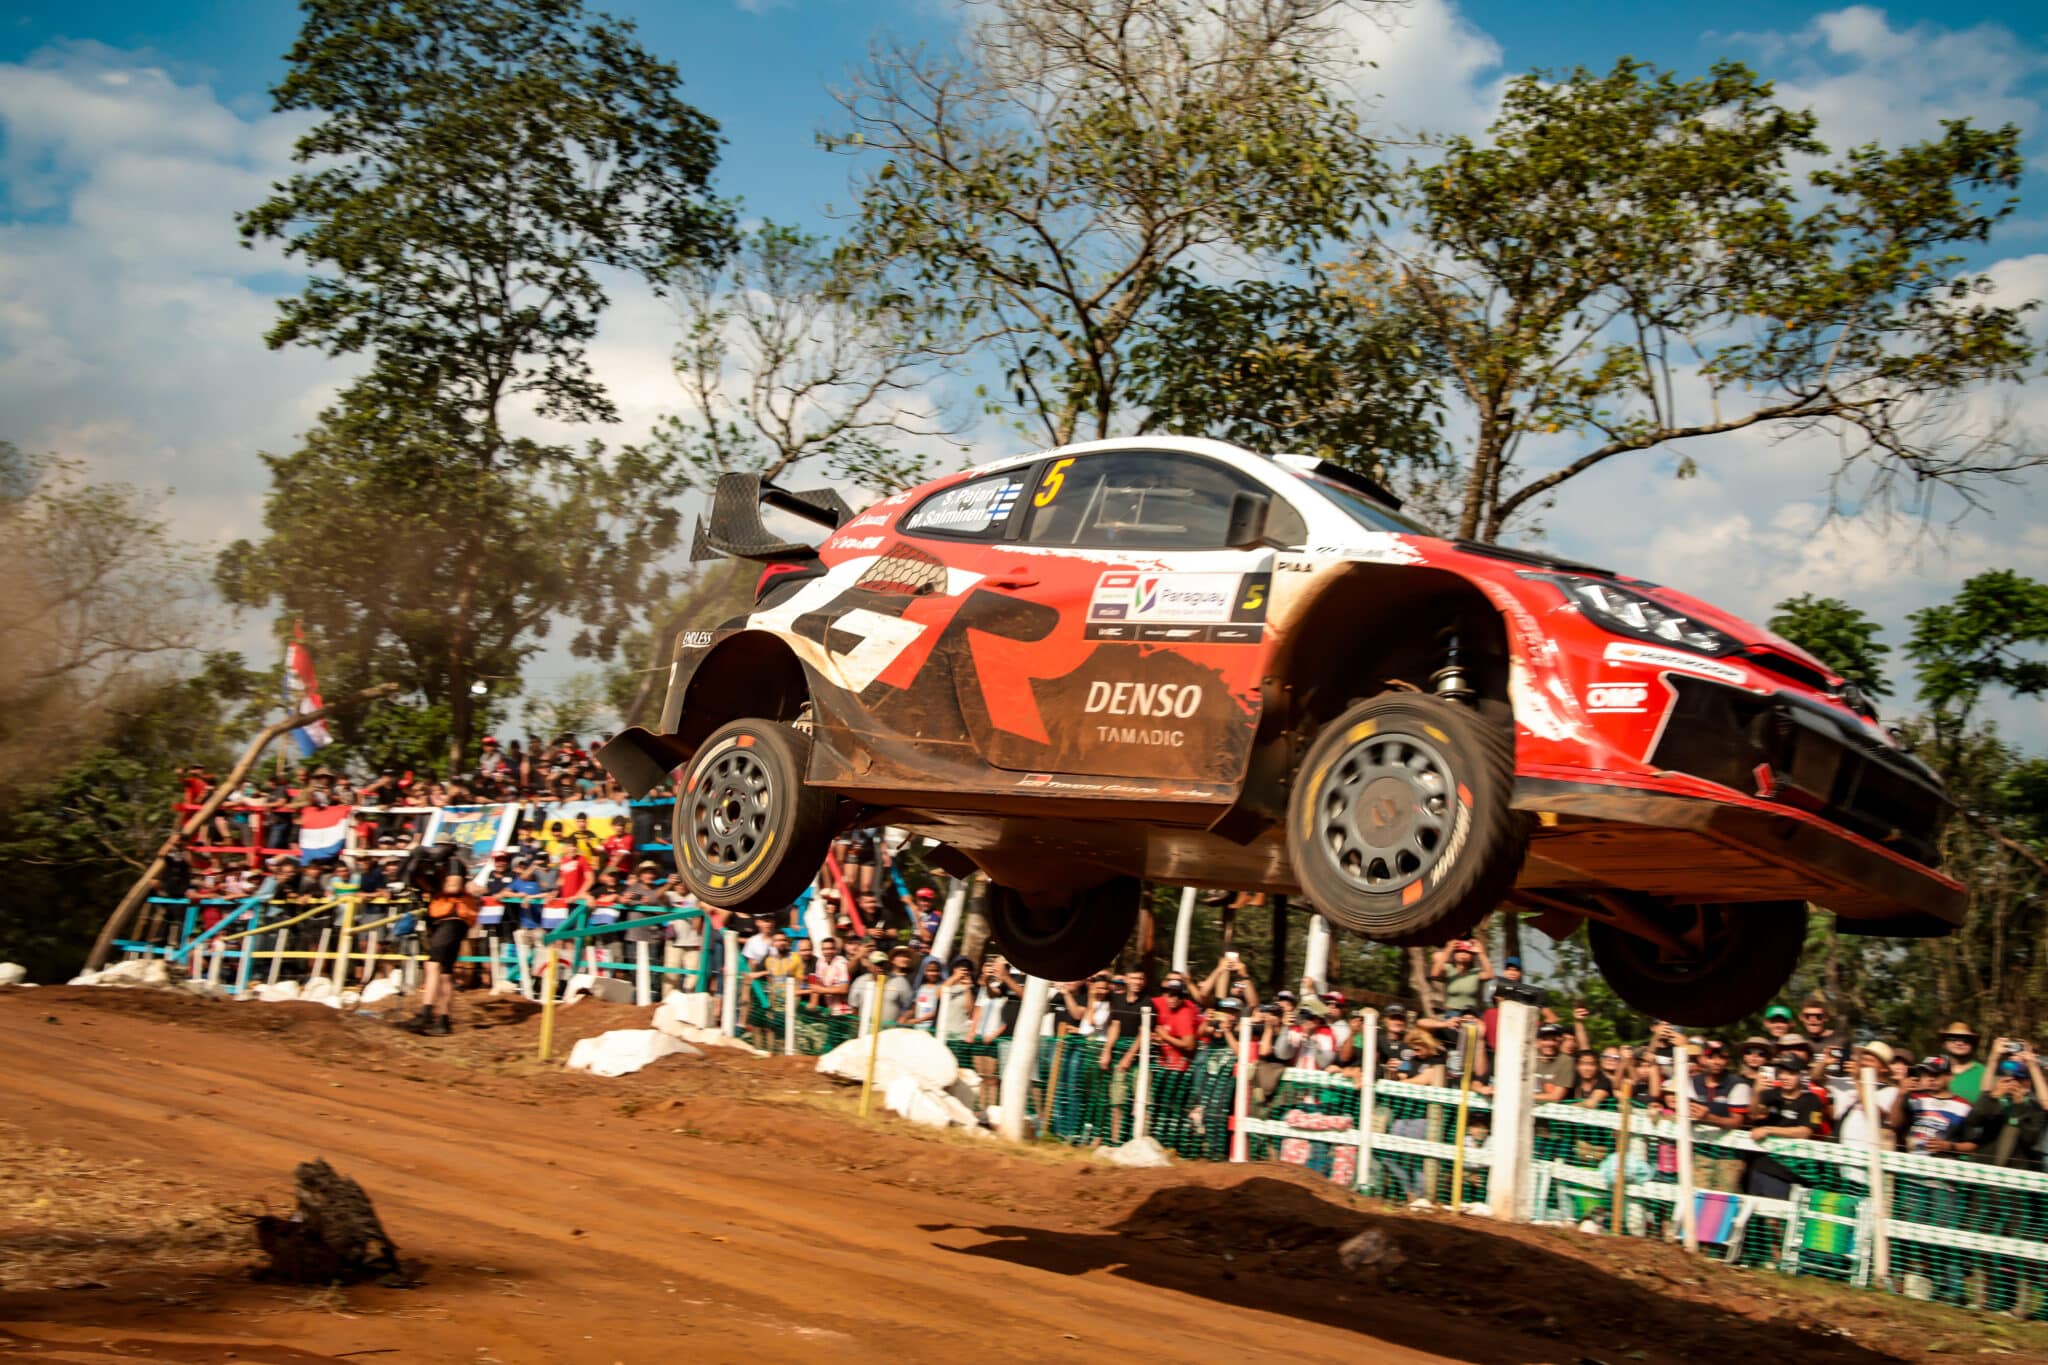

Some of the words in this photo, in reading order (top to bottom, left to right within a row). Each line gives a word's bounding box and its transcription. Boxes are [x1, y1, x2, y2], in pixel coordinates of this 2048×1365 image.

[1033, 458, 1076, 507] 5
[1241, 584, 1265, 610] 5
[1083, 681, 1203, 719] DENSO
[1096, 726, 1185, 747] TAMADIC
